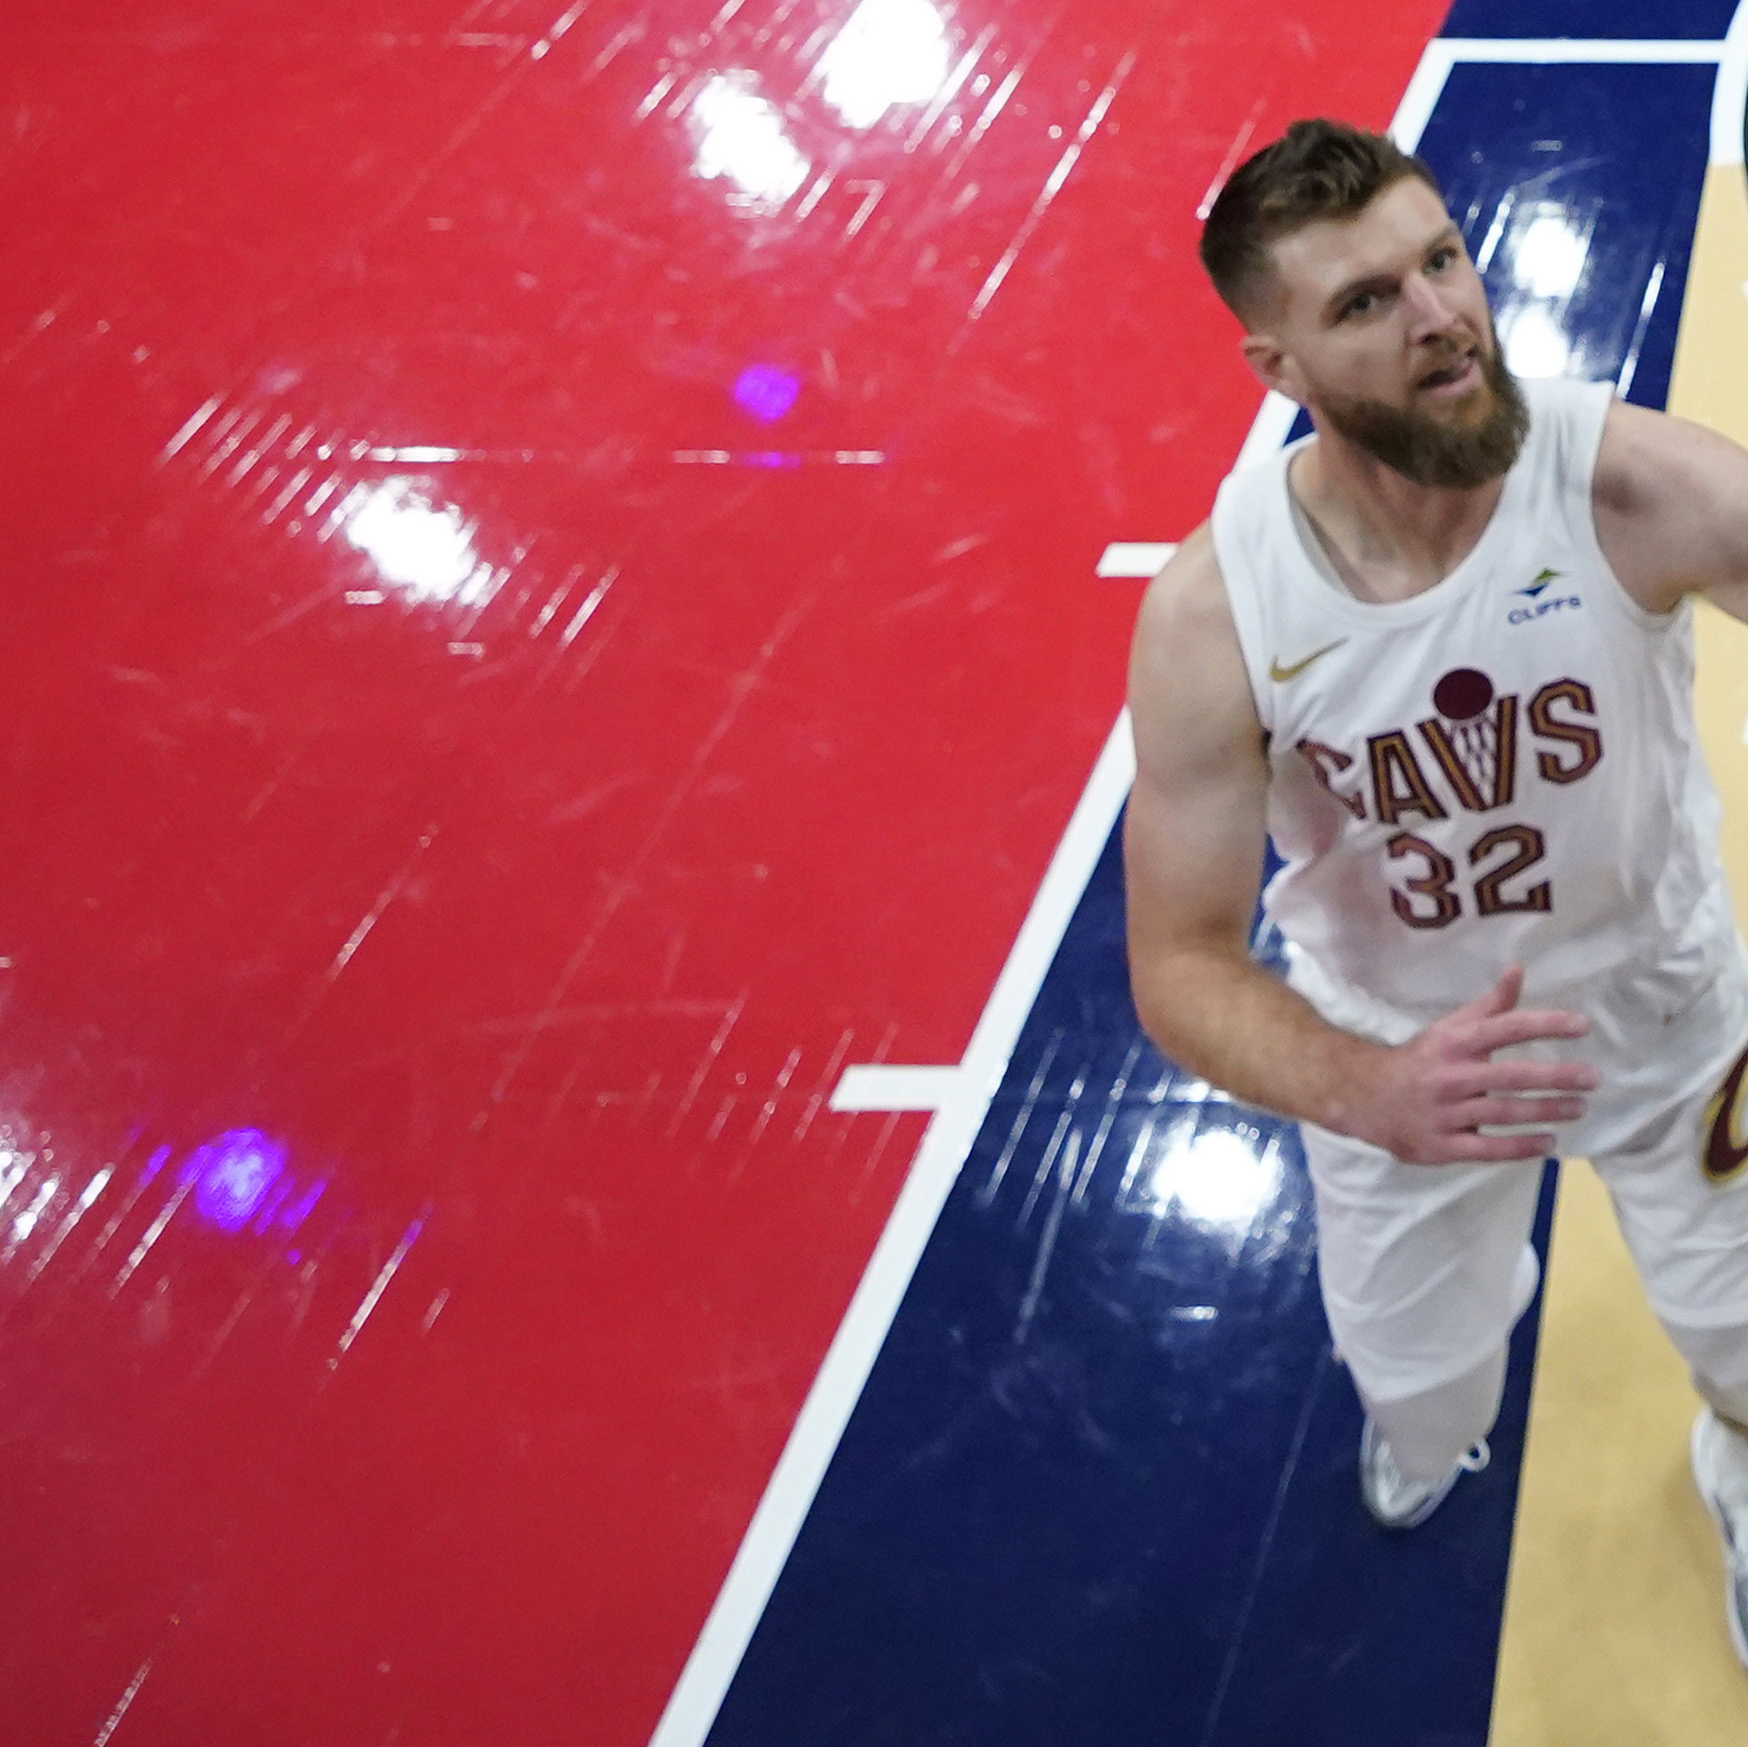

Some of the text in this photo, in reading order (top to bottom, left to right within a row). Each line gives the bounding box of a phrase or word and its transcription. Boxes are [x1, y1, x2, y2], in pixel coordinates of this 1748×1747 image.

[1507, 594, 1583, 625] CLIFFS
[1295, 674, 1606, 825] CAVS
[1386, 823, 1552, 931] 32
